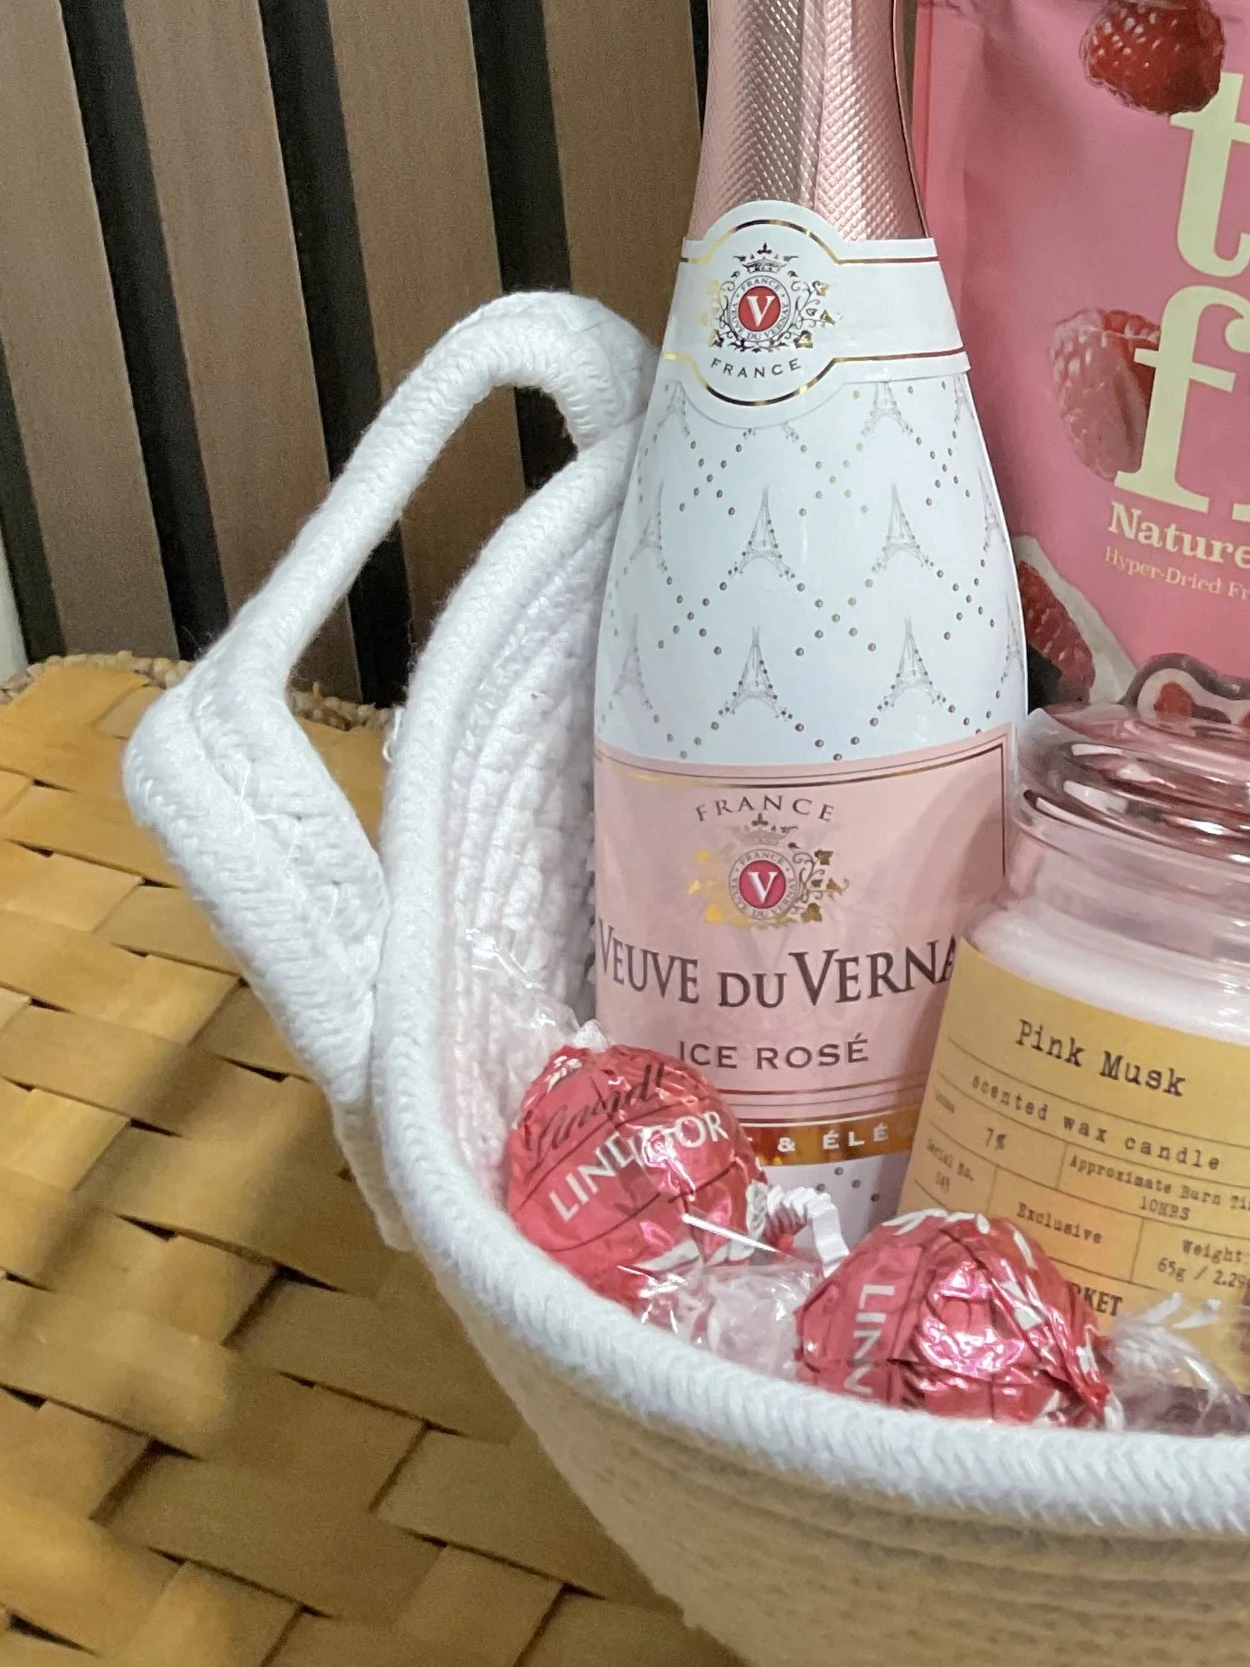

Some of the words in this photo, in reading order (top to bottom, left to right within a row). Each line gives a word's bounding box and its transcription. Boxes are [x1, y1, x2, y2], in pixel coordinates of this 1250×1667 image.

[747, 295, 776, 327] V
[710, 357, 802, 379] FRANCE
[1104, 546, 1221, 596] Hyper-Dried
[694, 794, 835, 822] FRANCE
[747, 871, 778, 904] V
[599, 917, 700, 1004] VEUVE
[718, 971, 788, 1009] DU
[788, 934, 957, 1006] VERNA
[678, 1040, 738, 1070] ICE
[755, 1032, 869, 1070] ROSÉ
[1015, 1019, 1085, 1068] Pink
[1099, 1050, 1187, 1097] Musk
[777, 1137, 796, 1153] &
[822, 1122, 890, 1150] ÉLÉ
[971, 1075, 1048, 1121] scented
[1063, 1114, 1107, 1144] wax
[1124, 1135, 1221, 1171] candle
[1068, 1155, 1173, 1195] Approximate
[1180, 1185, 1222, 1207] Burn
[1016, 1202, 1103, 1245] Exclusive
[1192, 1265, 1208, 1281] /
